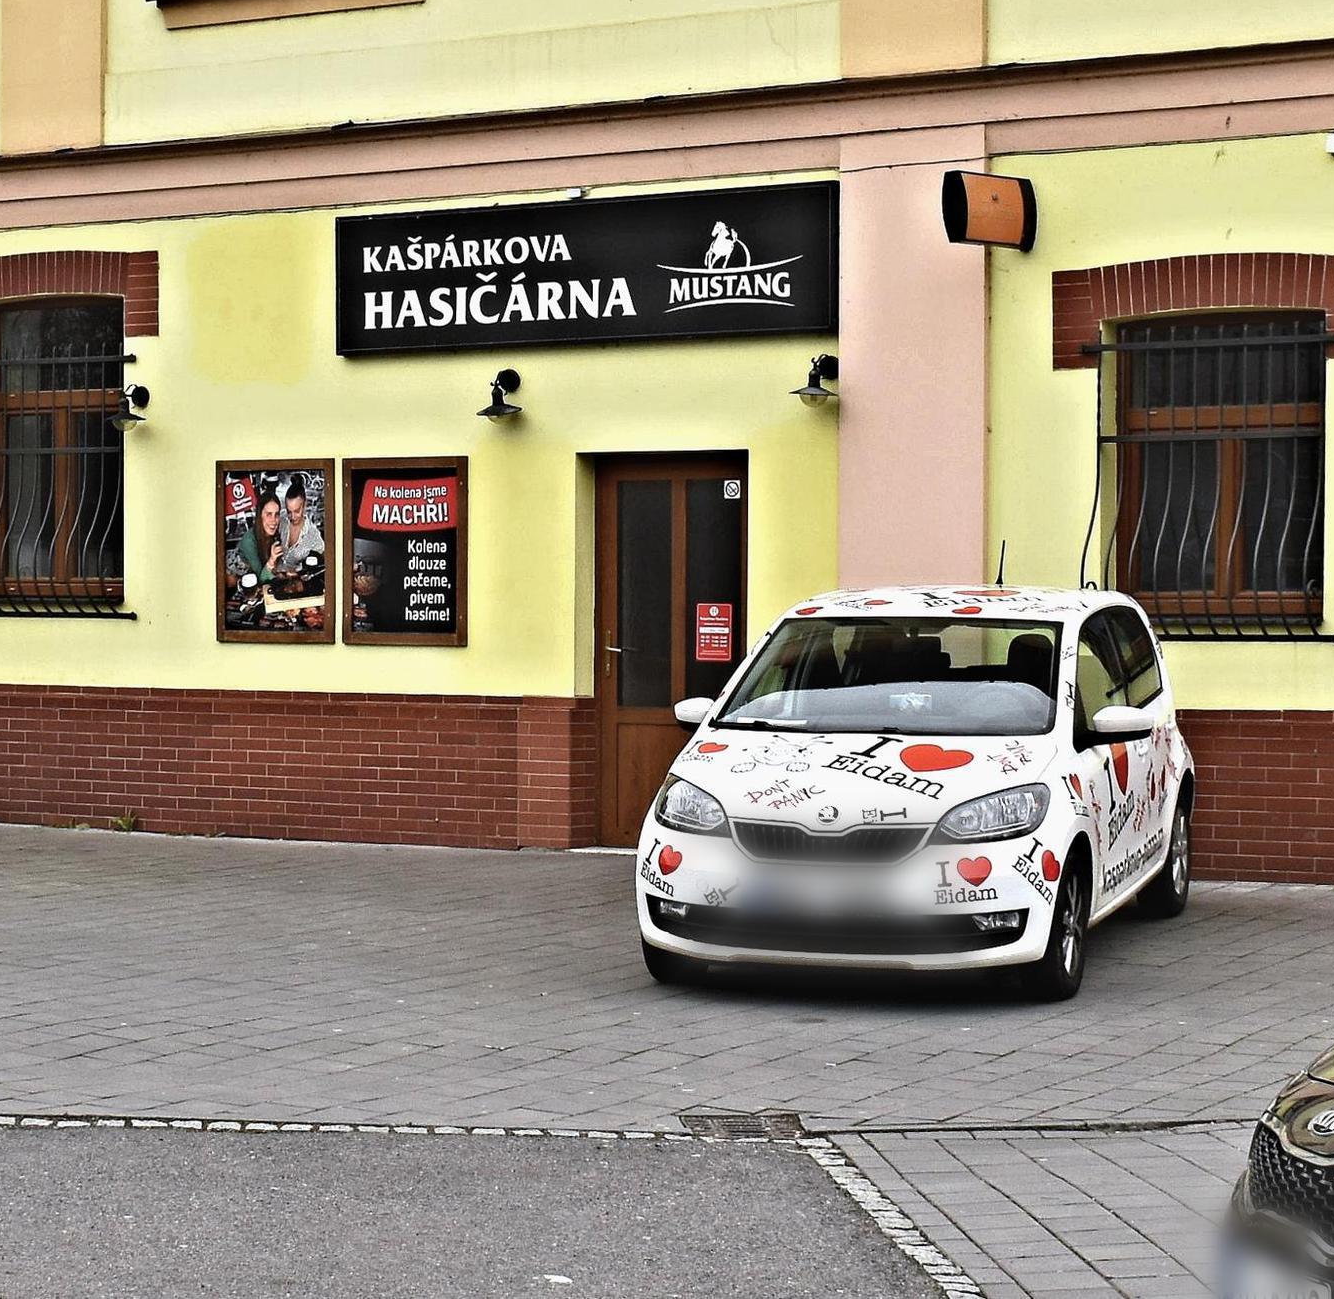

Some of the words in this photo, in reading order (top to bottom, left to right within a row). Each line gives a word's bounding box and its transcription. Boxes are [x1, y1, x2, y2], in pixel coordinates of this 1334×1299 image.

[363, 234, 572, 273] KAŠPÁRKOVA
[669, 271, 792, 303] MUSTANG
[363, 271, 638, 330] HASIČÁRNA
[374, 486, 388, 498] Na
[390, 485, 421, 499] kolena
[423, 485, 447, 499] jsme
[372, 498, 449, 525] MACHŘI!
[407, 539, 447, 553] Kolena
[408, 556, 447, 570] dlouze
[403, 572, 451, 589] pečeme,
[409, 590, 445, 606] pivem
[404, 606, 450, 621] hasíme!
[850, 736, 903, 759] I
[822, 754, 945, 801] Eidam
[644, 838, 661, 864] I
[1023, 837, 1043, 863] I
[640, 861, 674, 897] Eidam
[935, 861, 952, 888] I
[1011, 855, 1054, 906] Eidam
[933, 885, 998, 906] Eidam
